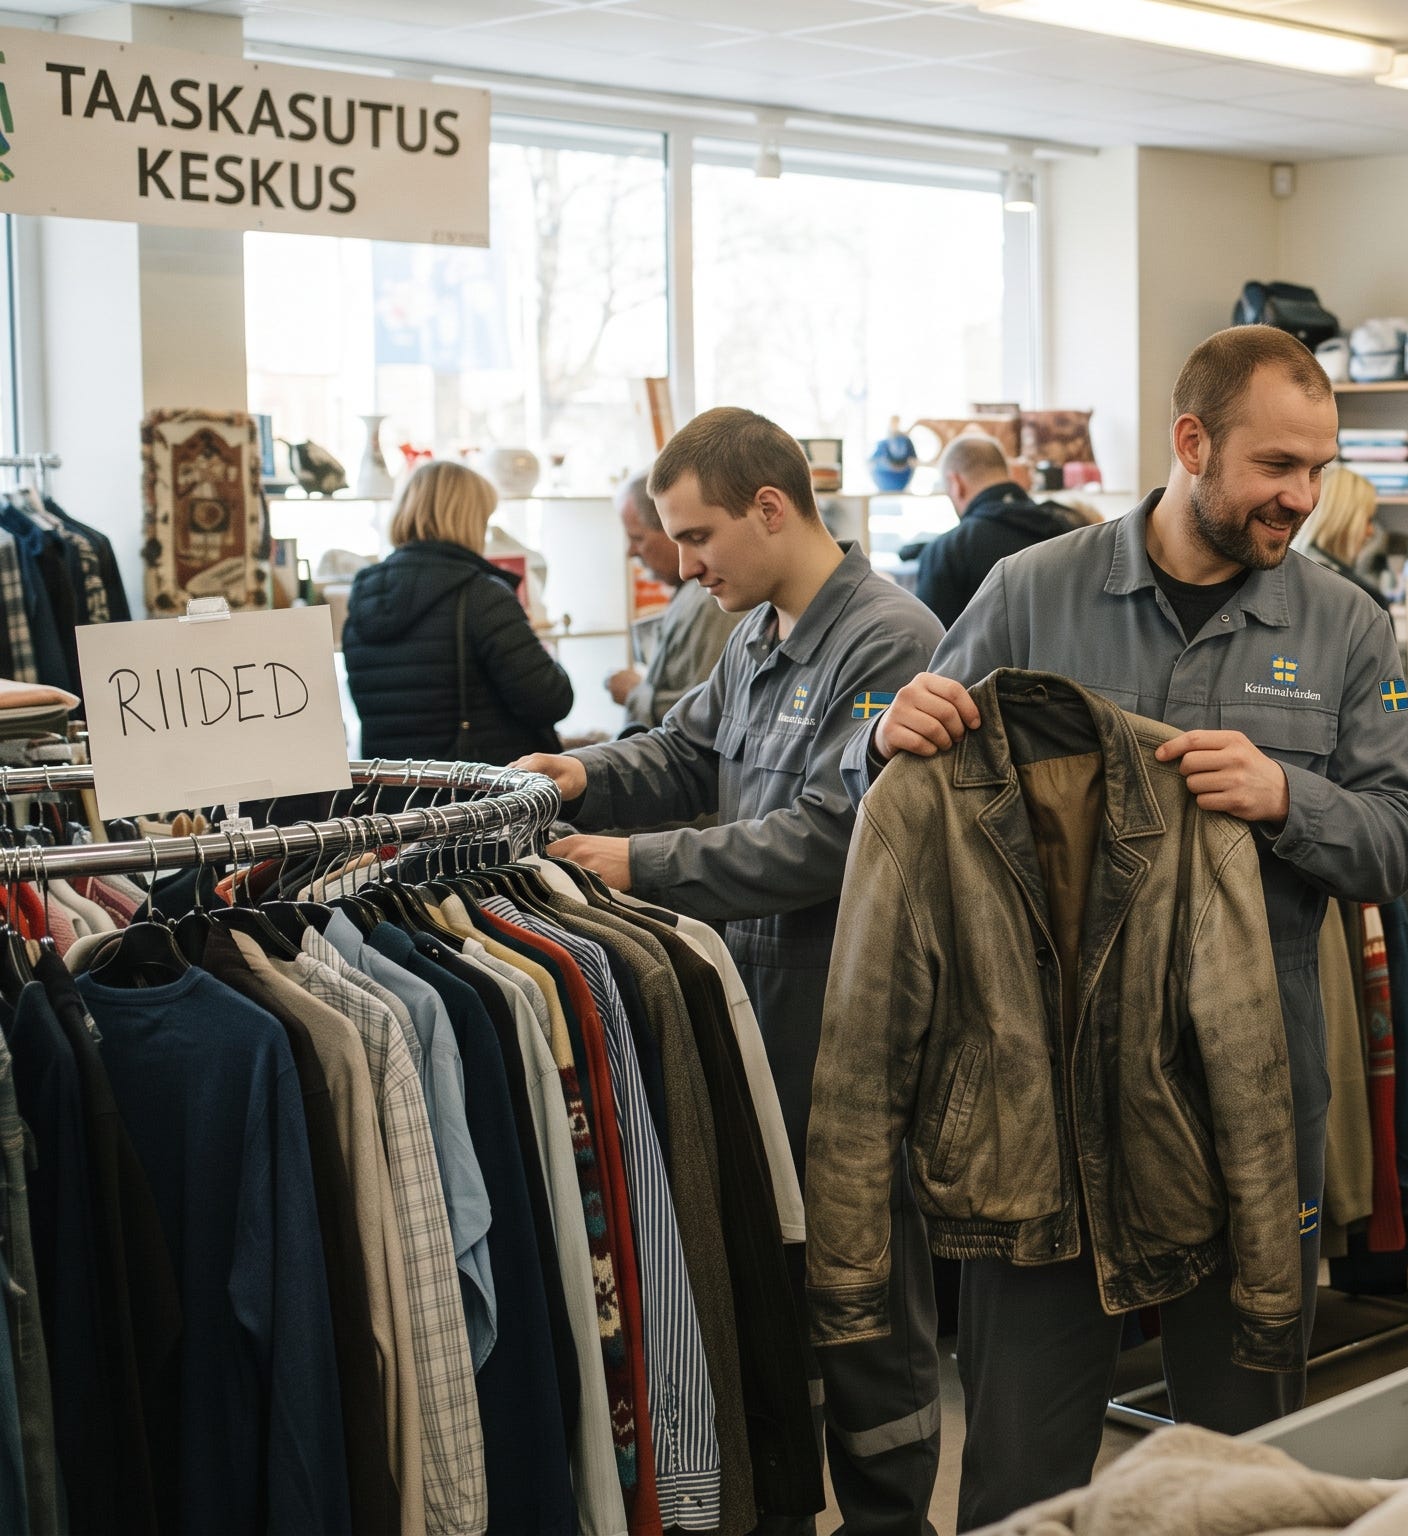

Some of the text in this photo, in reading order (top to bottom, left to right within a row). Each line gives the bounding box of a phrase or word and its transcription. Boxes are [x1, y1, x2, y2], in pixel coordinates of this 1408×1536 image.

[46, 62, 460, 157] TAASKASUTUS
[137, 147, 356, 214] KESKUS
[109, 662, 308, 736] RIIDED
